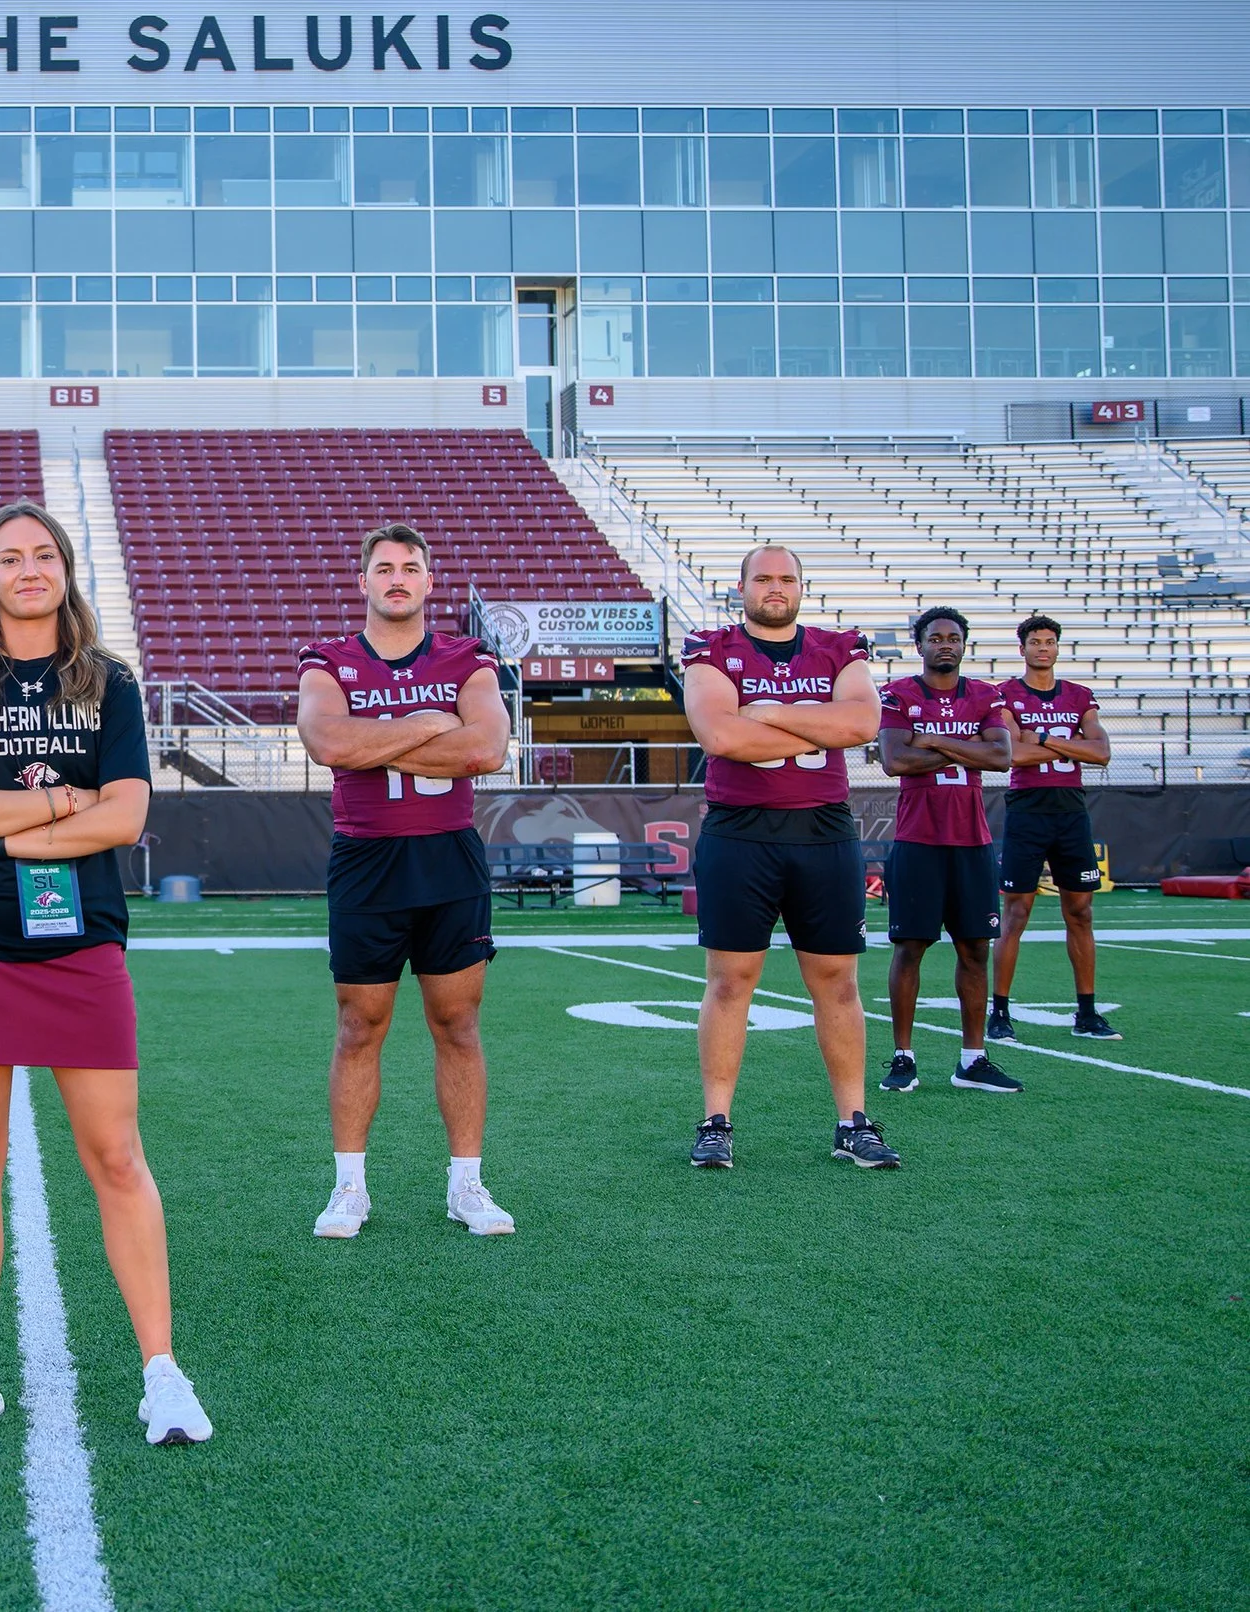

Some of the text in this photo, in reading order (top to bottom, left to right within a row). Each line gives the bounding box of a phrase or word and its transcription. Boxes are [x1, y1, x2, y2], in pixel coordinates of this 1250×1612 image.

[126, 13, 513, 72] SALUKIS
[488, 388, 502, 403] 5
[594, 388, 609, 403] 4
[538, 607, 652, 619] GOOD VIBES &
[538, 620, 599, 631] CUSTOM
[603, 620, 654, 631] GOODS
[537, 644, 569, 655] FedEx
[560, 660, 576, 678] 5
[594, 662, 607, 676] 4
[742, 677, 831, 694] SALUKIS
[350, 683, 458, 710] SALUKIS
[1020, 712, 1079, 724] SALUKIS
[913, 721, 981, 735] SALUKIS
[33, 874, 60, 889] SL
[1080, 869, 1100, 880] SIU
